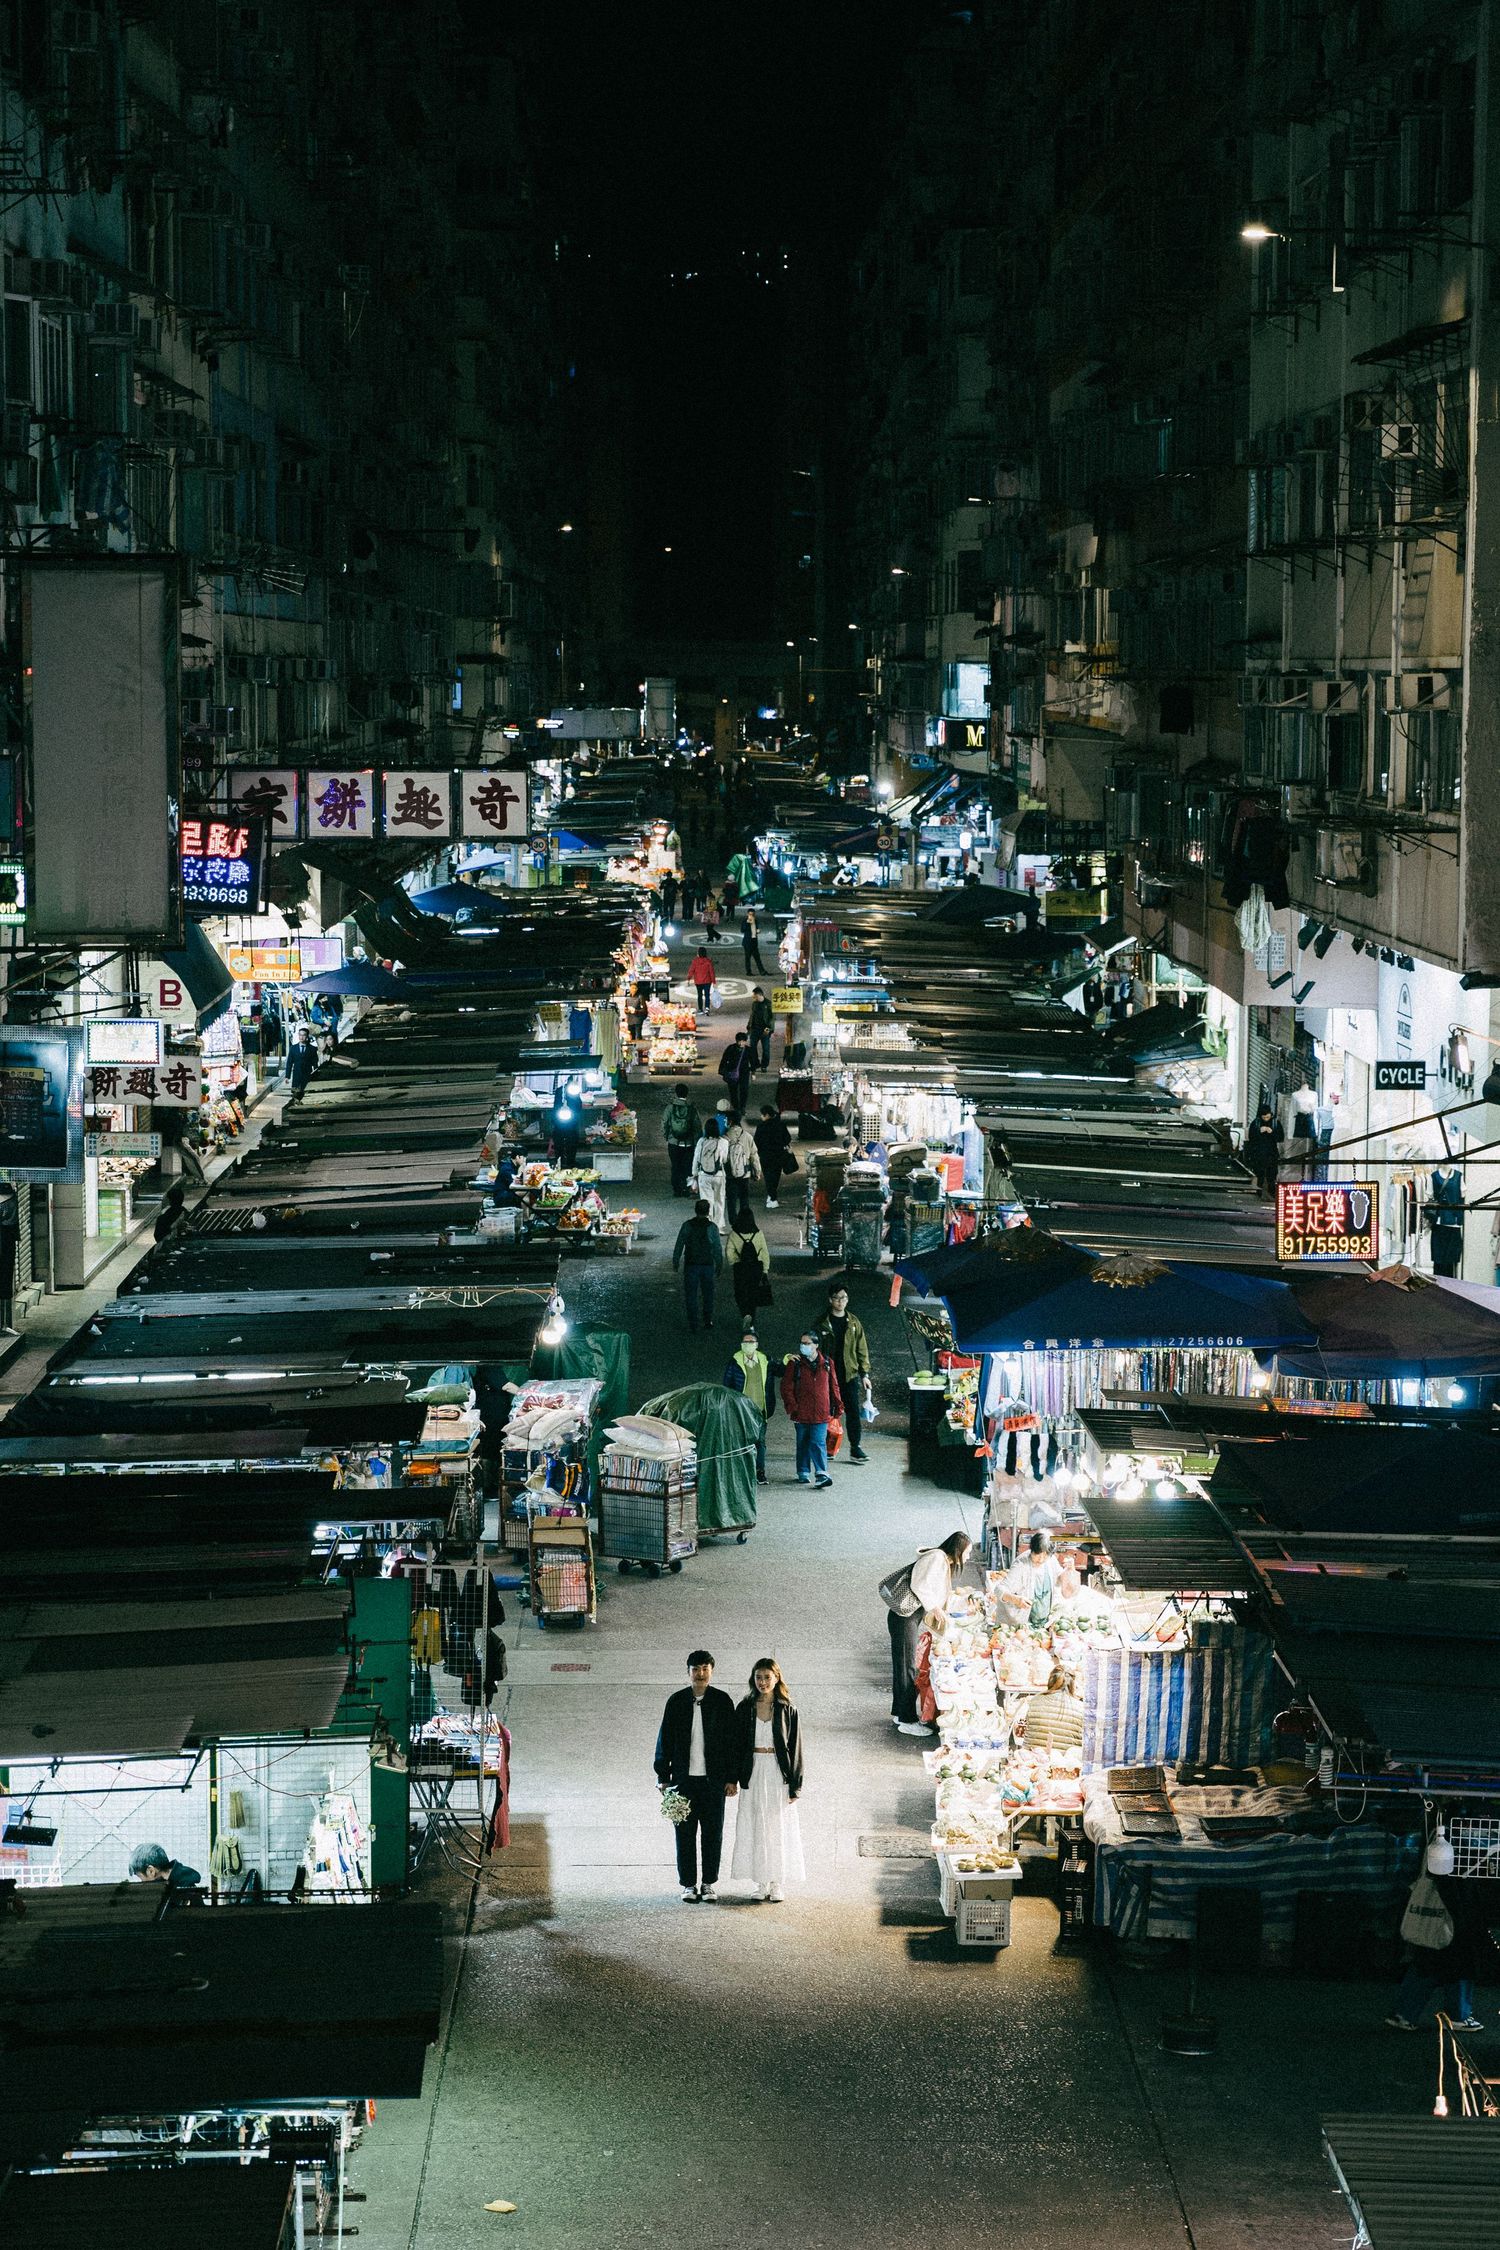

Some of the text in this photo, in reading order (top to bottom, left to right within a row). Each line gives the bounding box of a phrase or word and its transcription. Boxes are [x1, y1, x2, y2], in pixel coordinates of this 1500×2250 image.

[533, 841, 544, 849] 30
[160, 979, 182, 1006] B
[1379, 1068, 1424, 1084] CYCLE
[1285, 1188, 1345, 1234] 美足樂
[1284, 1236, 1371, 1254] 91755993
